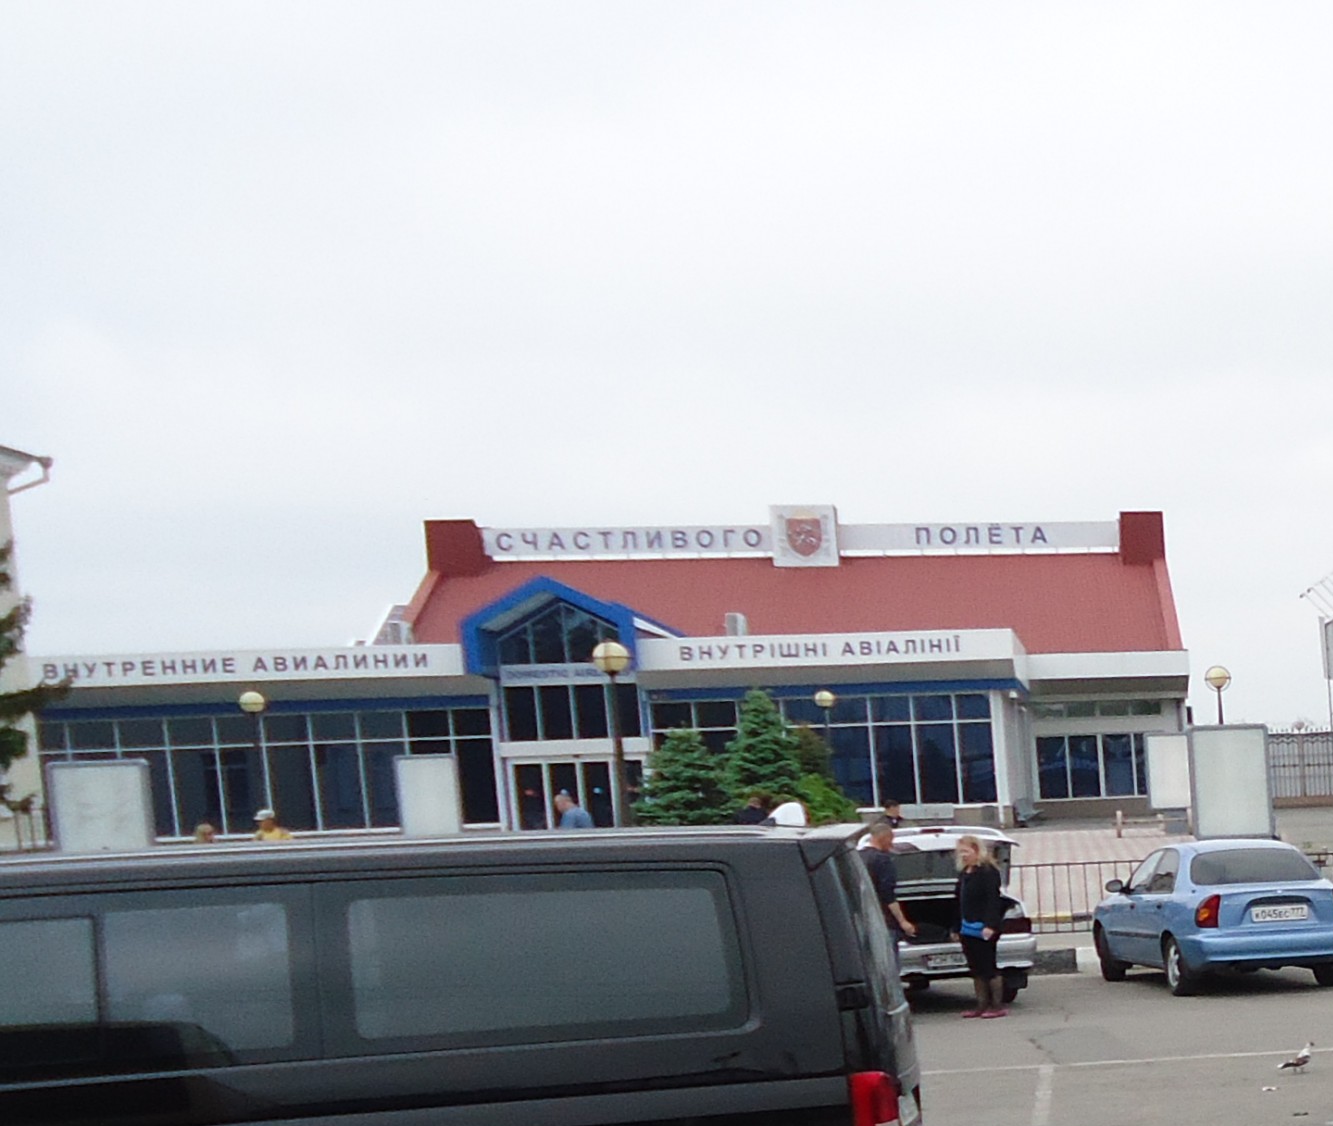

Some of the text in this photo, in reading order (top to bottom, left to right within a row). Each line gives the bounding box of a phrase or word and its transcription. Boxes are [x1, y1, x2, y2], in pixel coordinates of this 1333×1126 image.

[495, 523, 1048, 551] СЧАСТЛИВОГО ПОЛЁТА
[679, 635, 961, 661] ВНУТРІШНІ АВІАЛІНІЇ
[42, 653, 429, 680] ВНУТРЕННИЕ АВИАЛИНИИ
